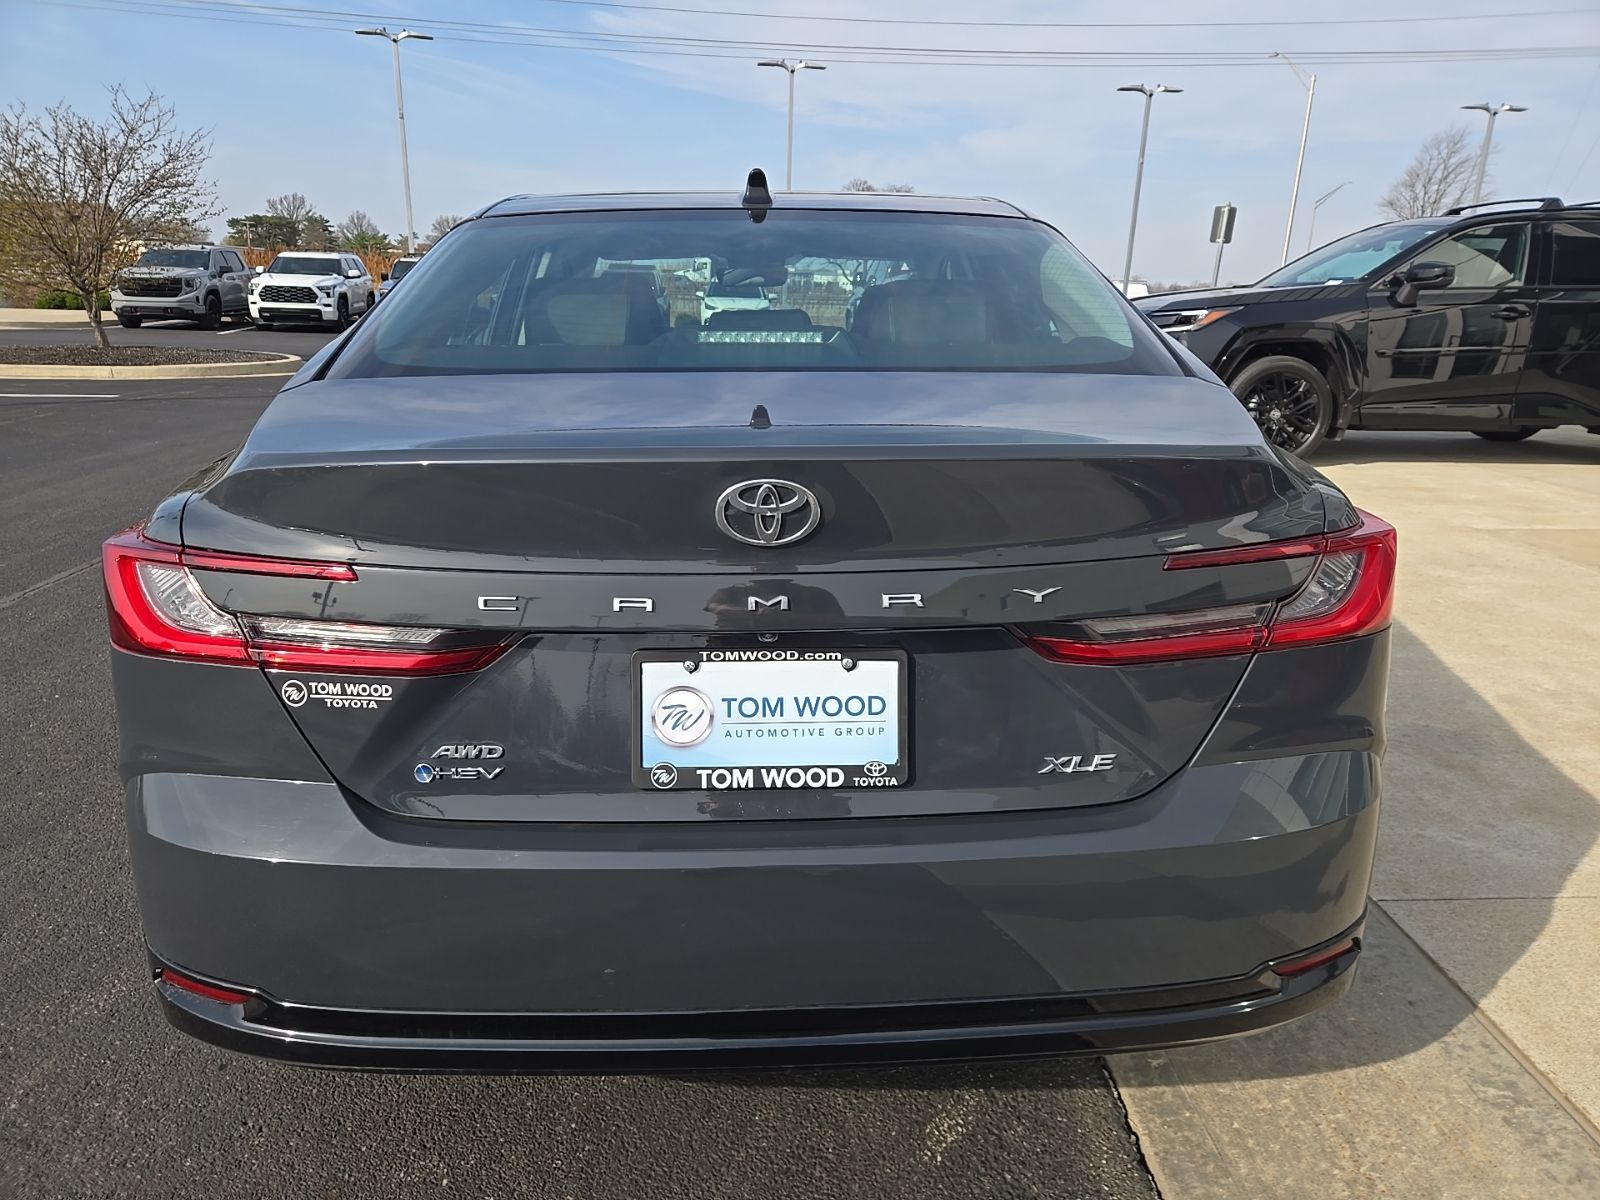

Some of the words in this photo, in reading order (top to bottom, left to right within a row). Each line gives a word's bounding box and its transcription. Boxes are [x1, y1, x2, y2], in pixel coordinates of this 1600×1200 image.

[477, 586, 1063, 612] CAMRY
[699, 650, 842, 661] TOMWOOD.com
[309, 682, 342, 695] TOM
[344, 683, 393, 697] WOOD
[324, 699, 378, 709] TOYOTA
[721, 697, 784, 718] TOM
[794, 695, 887, 717] WOOD
[724, 728, 825, 738] AUTOMOTIVE
[835, 727, 885, 737] GROUP
[431, 745, 505, 758] AWD
[1037, 753, 1118, 774] XLE
[696, 769, 755, 789] TOM
[761, 767, 845, 787] WOOD
[853, 777, 898, 786] TOYOTA
